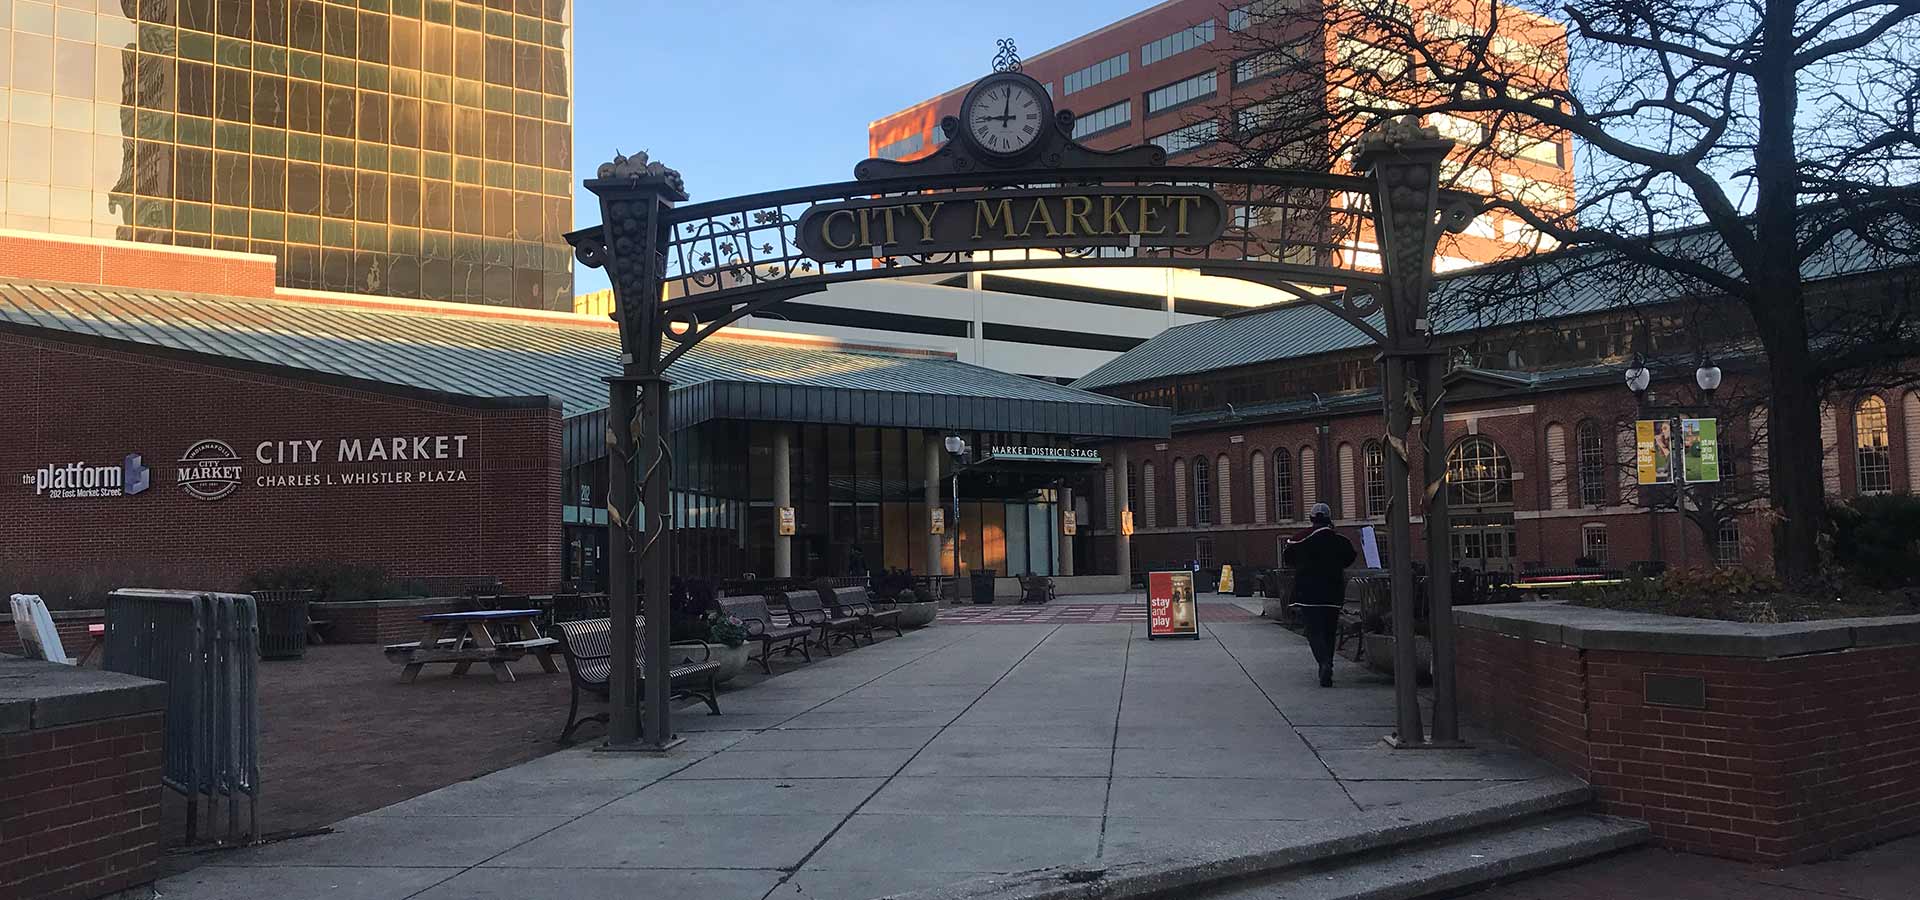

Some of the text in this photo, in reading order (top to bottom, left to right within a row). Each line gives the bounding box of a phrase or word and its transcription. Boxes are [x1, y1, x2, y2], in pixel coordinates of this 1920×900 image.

[822, 195, 1201, 249] CITY MARKET
[189, 443, 231, 459] INDIANAPOLIS
[256, 435, 468, 464] CITY MARKET
[992, 445, 1098, 458] MARKET DISTRICT STAGE
[22, 461, 121, 495] the platform
[177, 466, 242, 482] MARKET
[256, 470, 467, 487] CHARLES L. WHISTLER PLAZA
[49, 487, 122, 499] 202 East Market Street
[1151, 597, 1170, 608] stay
[1152, 607, 1166, 616] and
[1152, 616, 1170, 627] play
